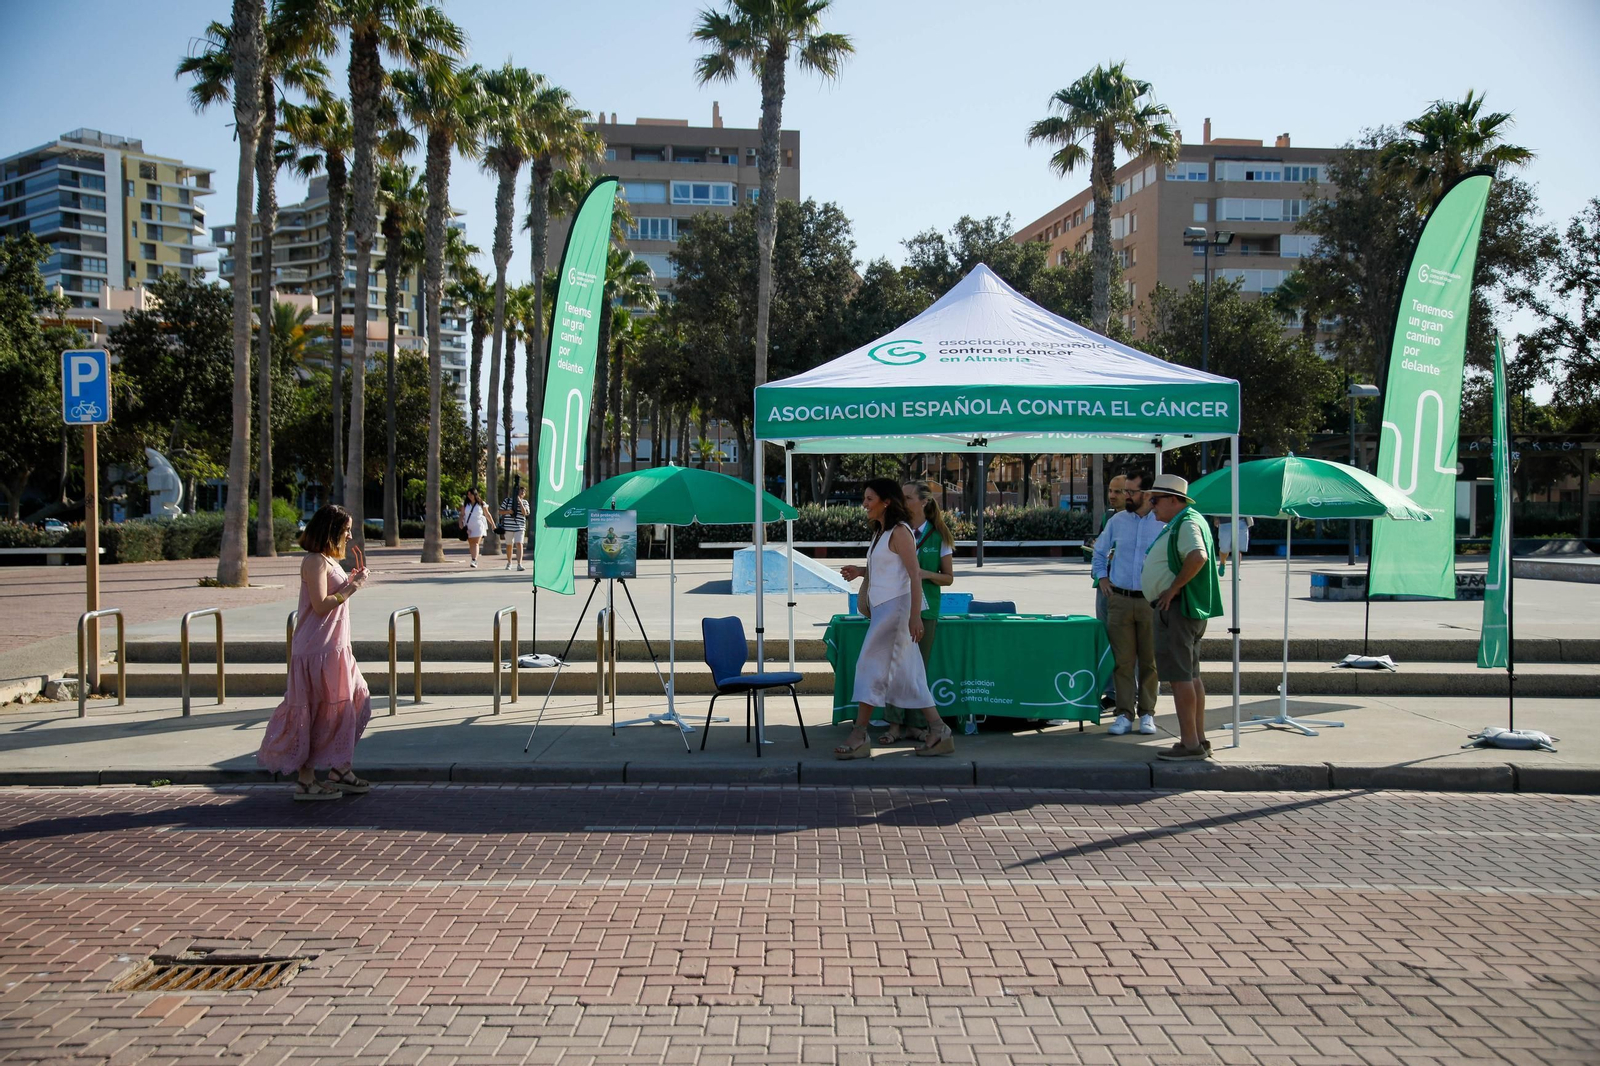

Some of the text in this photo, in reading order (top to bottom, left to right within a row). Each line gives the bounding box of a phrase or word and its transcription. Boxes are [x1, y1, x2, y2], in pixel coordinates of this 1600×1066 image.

[1412, 299, 1454, 319] Tenemos
[562, 317, 570, 328] un
[1408, 316, 1443, 332] un gran
[938, 337, 1026, 347] asociación
[1406, 331, 1441, 347] camino
[558, 346, 571, 357] por
[1016, 347, 1073, 356] cáncer
[1402, 345, 1420, 357] por
[964, 355, 1030, 363] Almería
[557, 358, 584, 375] delante
[1401, 358, 1441, 376] delante
[70, 356, 100, 397] P
[767, 395, 1229, 422] ASOCIACIÓN ESPAÑOLA CONTRA EL CÁNCER
[960, 679, 995, 687] asociación
[960, 687, 990, 695] española
